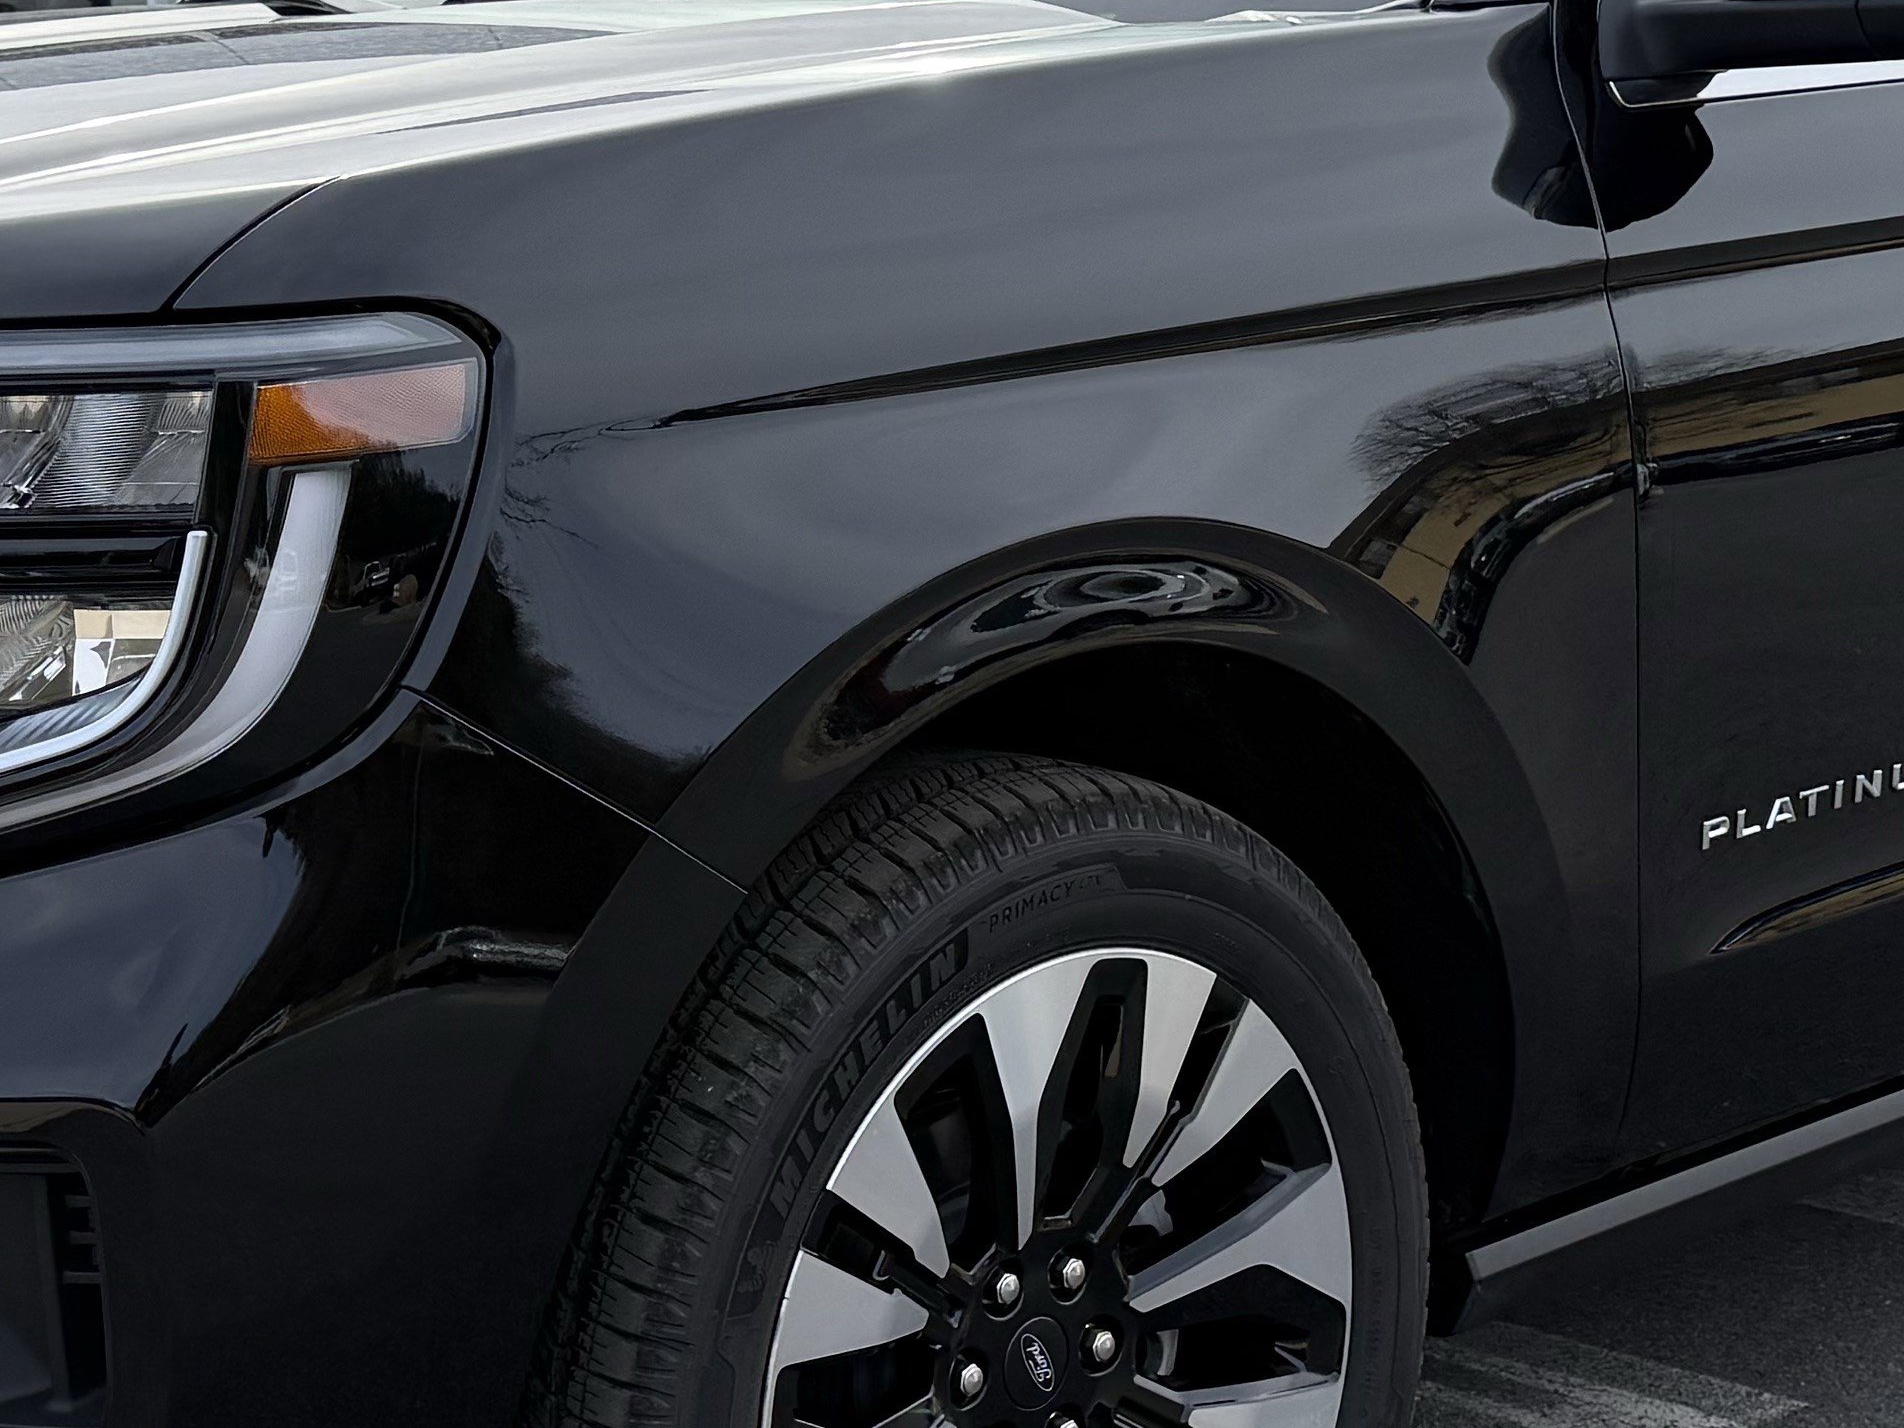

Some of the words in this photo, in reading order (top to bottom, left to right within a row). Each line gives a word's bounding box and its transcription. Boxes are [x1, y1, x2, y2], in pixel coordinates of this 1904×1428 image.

[989, 879, 1077, 933] PRIMACY
[768, 940, 958, 1219] MICHELIN
[1025, 1342, 1053, 1382] Ford
